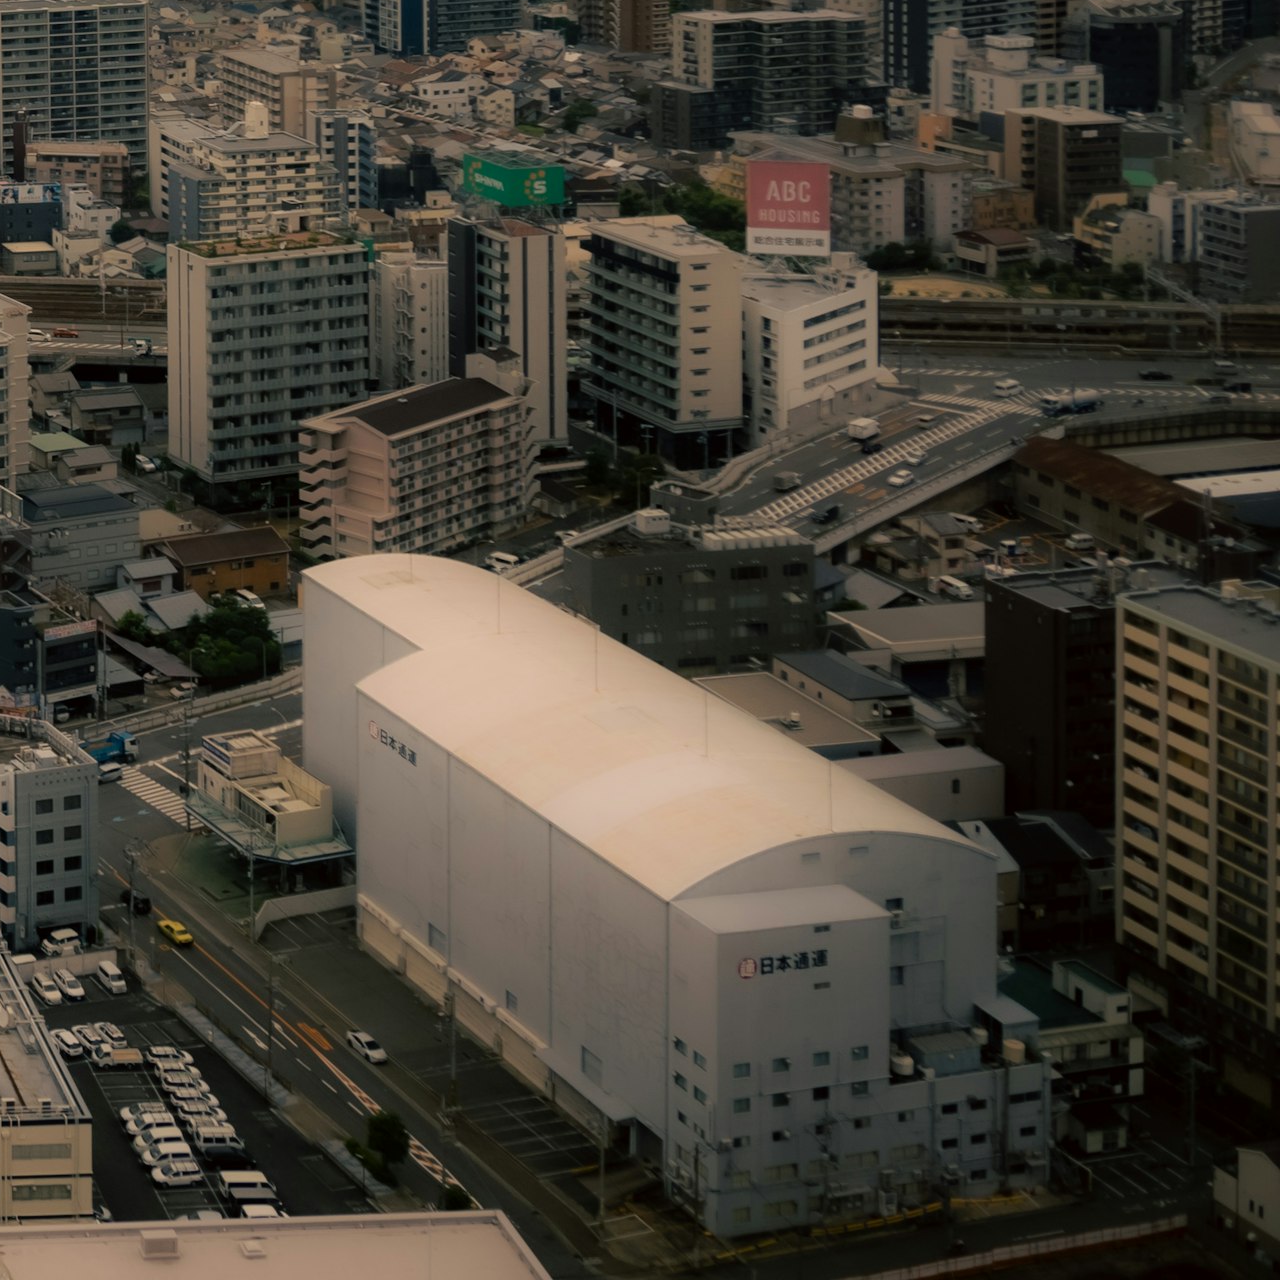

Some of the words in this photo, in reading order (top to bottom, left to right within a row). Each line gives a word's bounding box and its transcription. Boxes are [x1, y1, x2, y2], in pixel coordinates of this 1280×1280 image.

[767, 180, 811, 202] ABC
[759, 209, 820, 224] HOUSING
[761, 949, 828, 975] 日本通運
